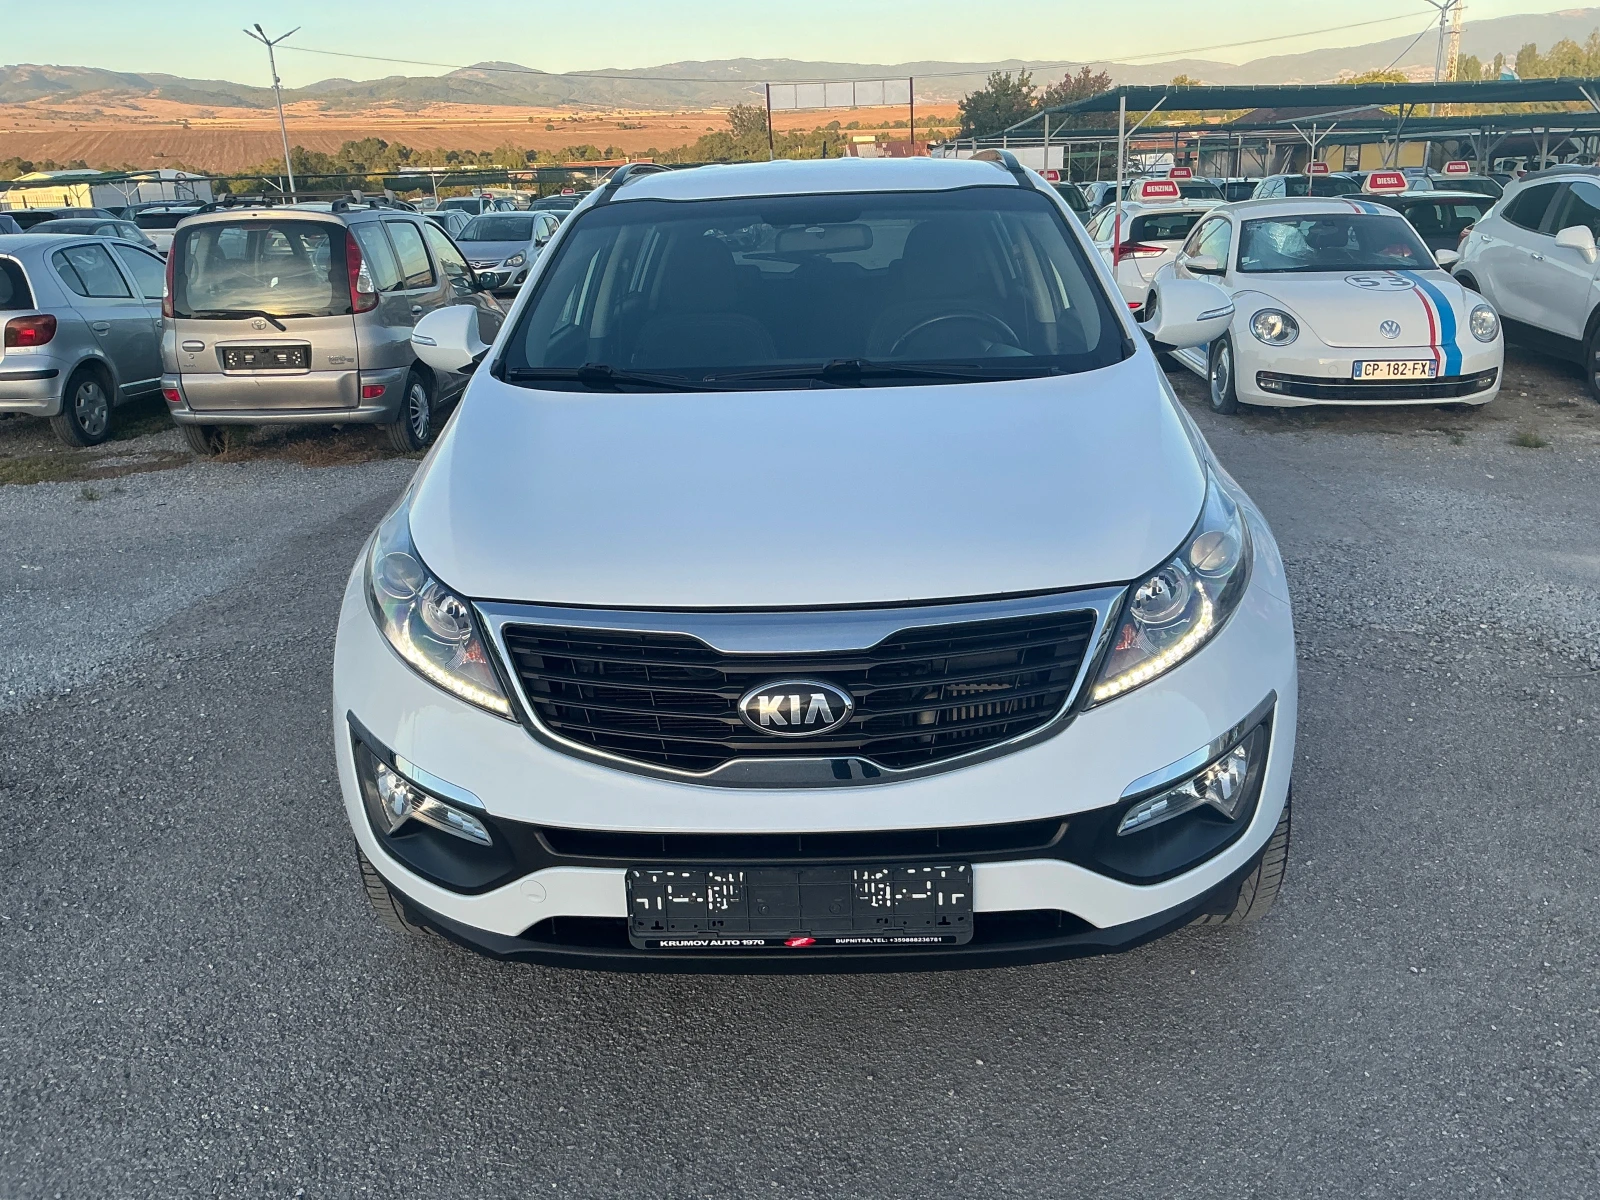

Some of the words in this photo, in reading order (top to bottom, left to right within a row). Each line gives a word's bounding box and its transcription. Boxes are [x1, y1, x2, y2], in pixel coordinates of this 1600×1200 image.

[1376, 177, 1398, 185] DIESEL
[1146, 185, 1174, 193] BENZINA
[1352, 276, 1411, 287] 53
[1364, 362, 1428, 376] CP-182-FX
[757, 693, 835, 726] KIA
